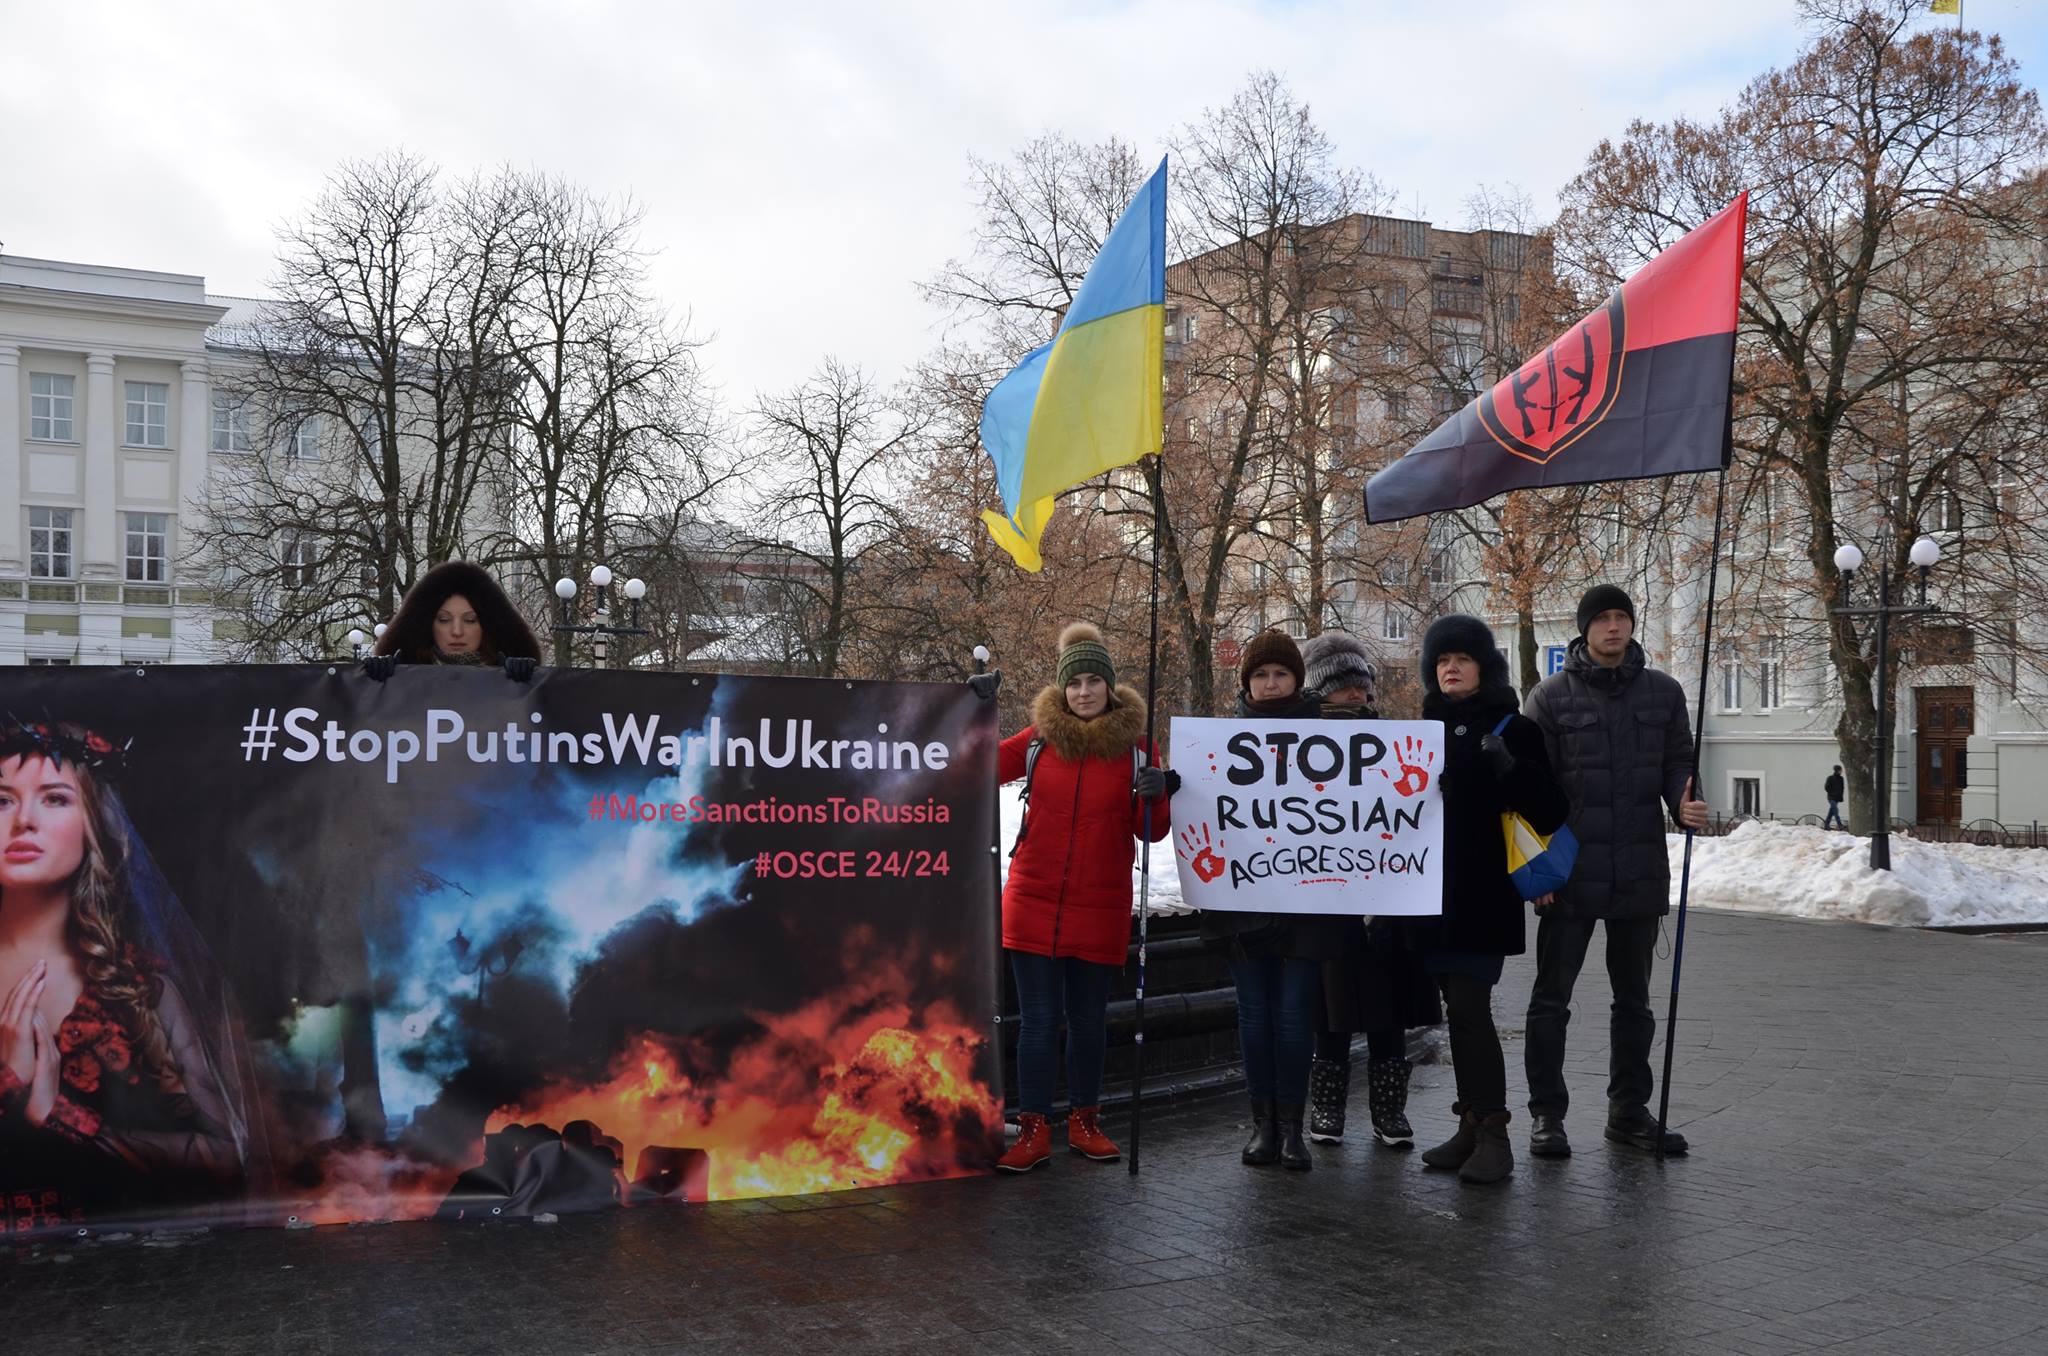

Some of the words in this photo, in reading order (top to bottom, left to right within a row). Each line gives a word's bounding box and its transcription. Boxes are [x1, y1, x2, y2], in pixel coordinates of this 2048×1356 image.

[240, 708, 950, 783] #StopPutinsWarInUkraine
[1226, 732, 1387, 786] STOP
[588, 793, 951, 824] #MoreSanctionsToRussia
[1217, 795, 1425, 835] RUSSIAN
[755, 852, 856, 879] #OSCE
[865, 850, 950, 879] 24/24
[1230, 845, 1429, 889] AGGRESSION
